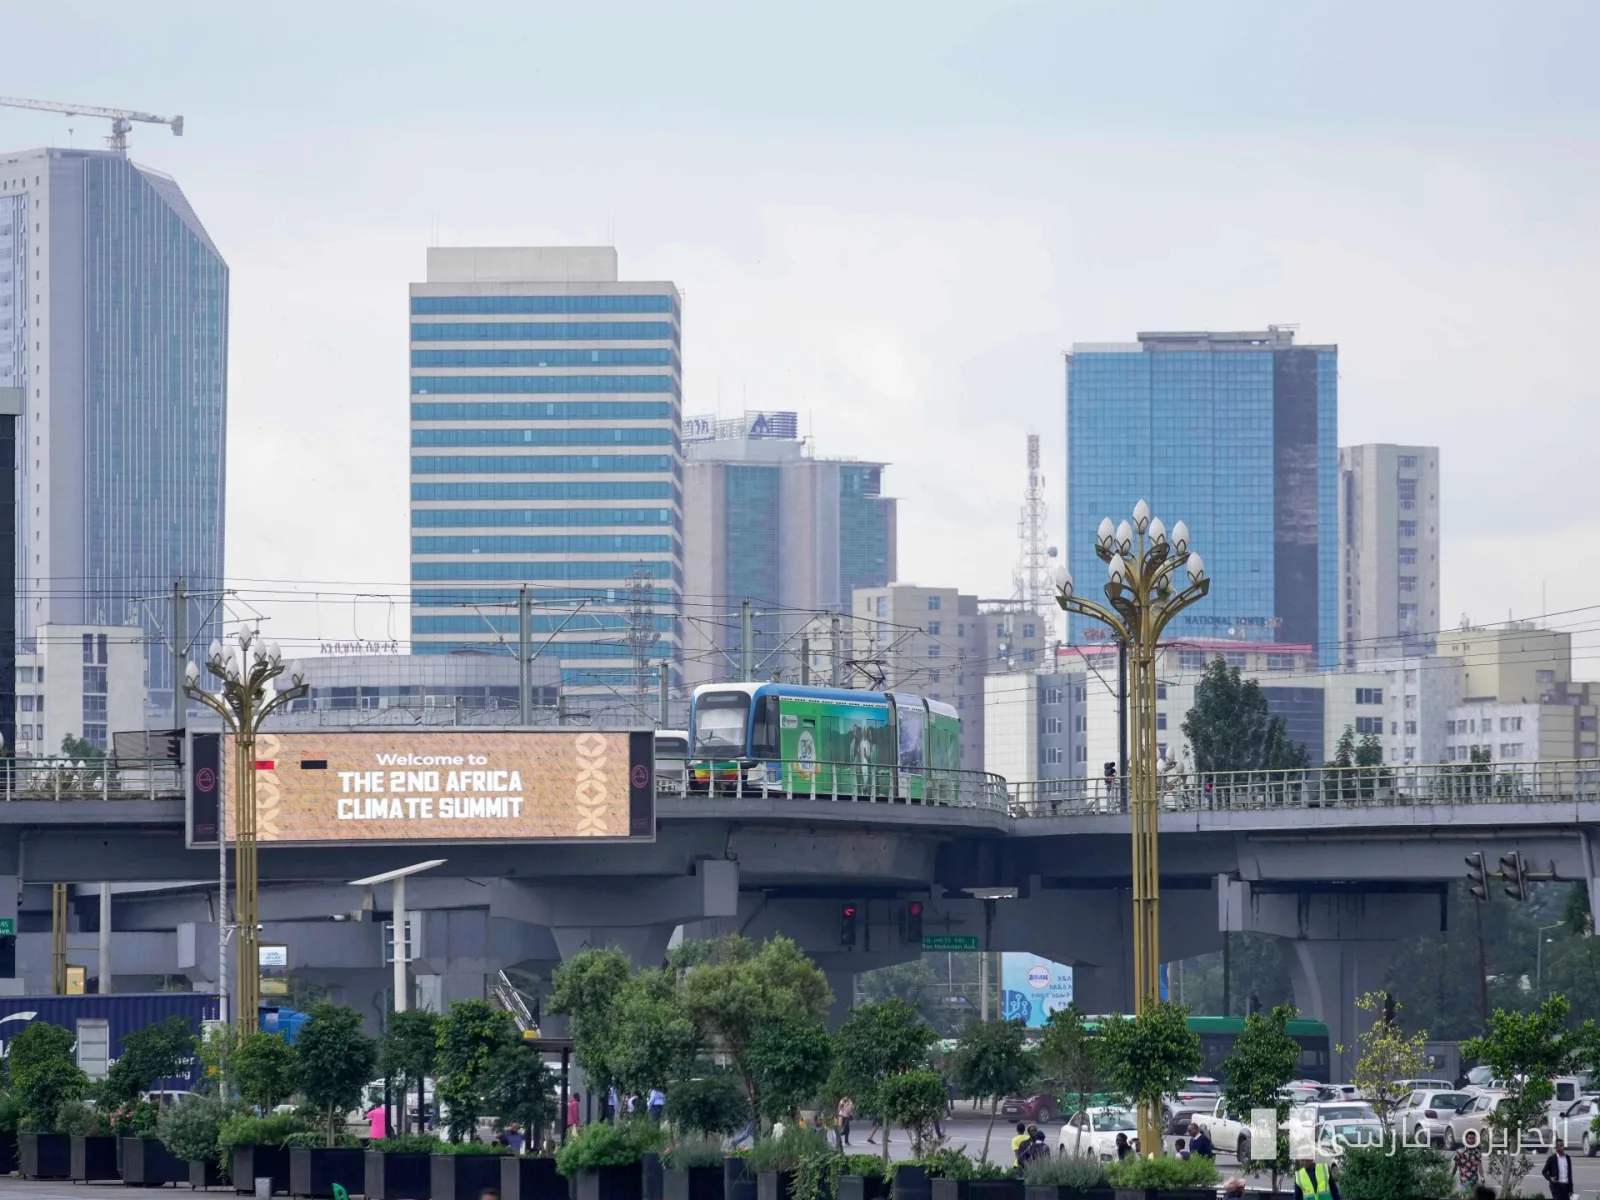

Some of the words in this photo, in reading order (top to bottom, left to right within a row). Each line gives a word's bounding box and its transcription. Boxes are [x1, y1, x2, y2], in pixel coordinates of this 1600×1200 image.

[1185, 616, 1232, 625] NATIONAL
[1236, 616, 1265, 626] TOWER
[376, 752, 464, 767] Welcome
[468, 754, 488, 766] to
[338, 771, 385, 792] THE
[391, 771, 440, 791] 2ND
[445, 770, 522, 791] AFRICA
[336, 797, 433, 820] CLIMATE
[440, 796, 523, 819] SUMMIT
